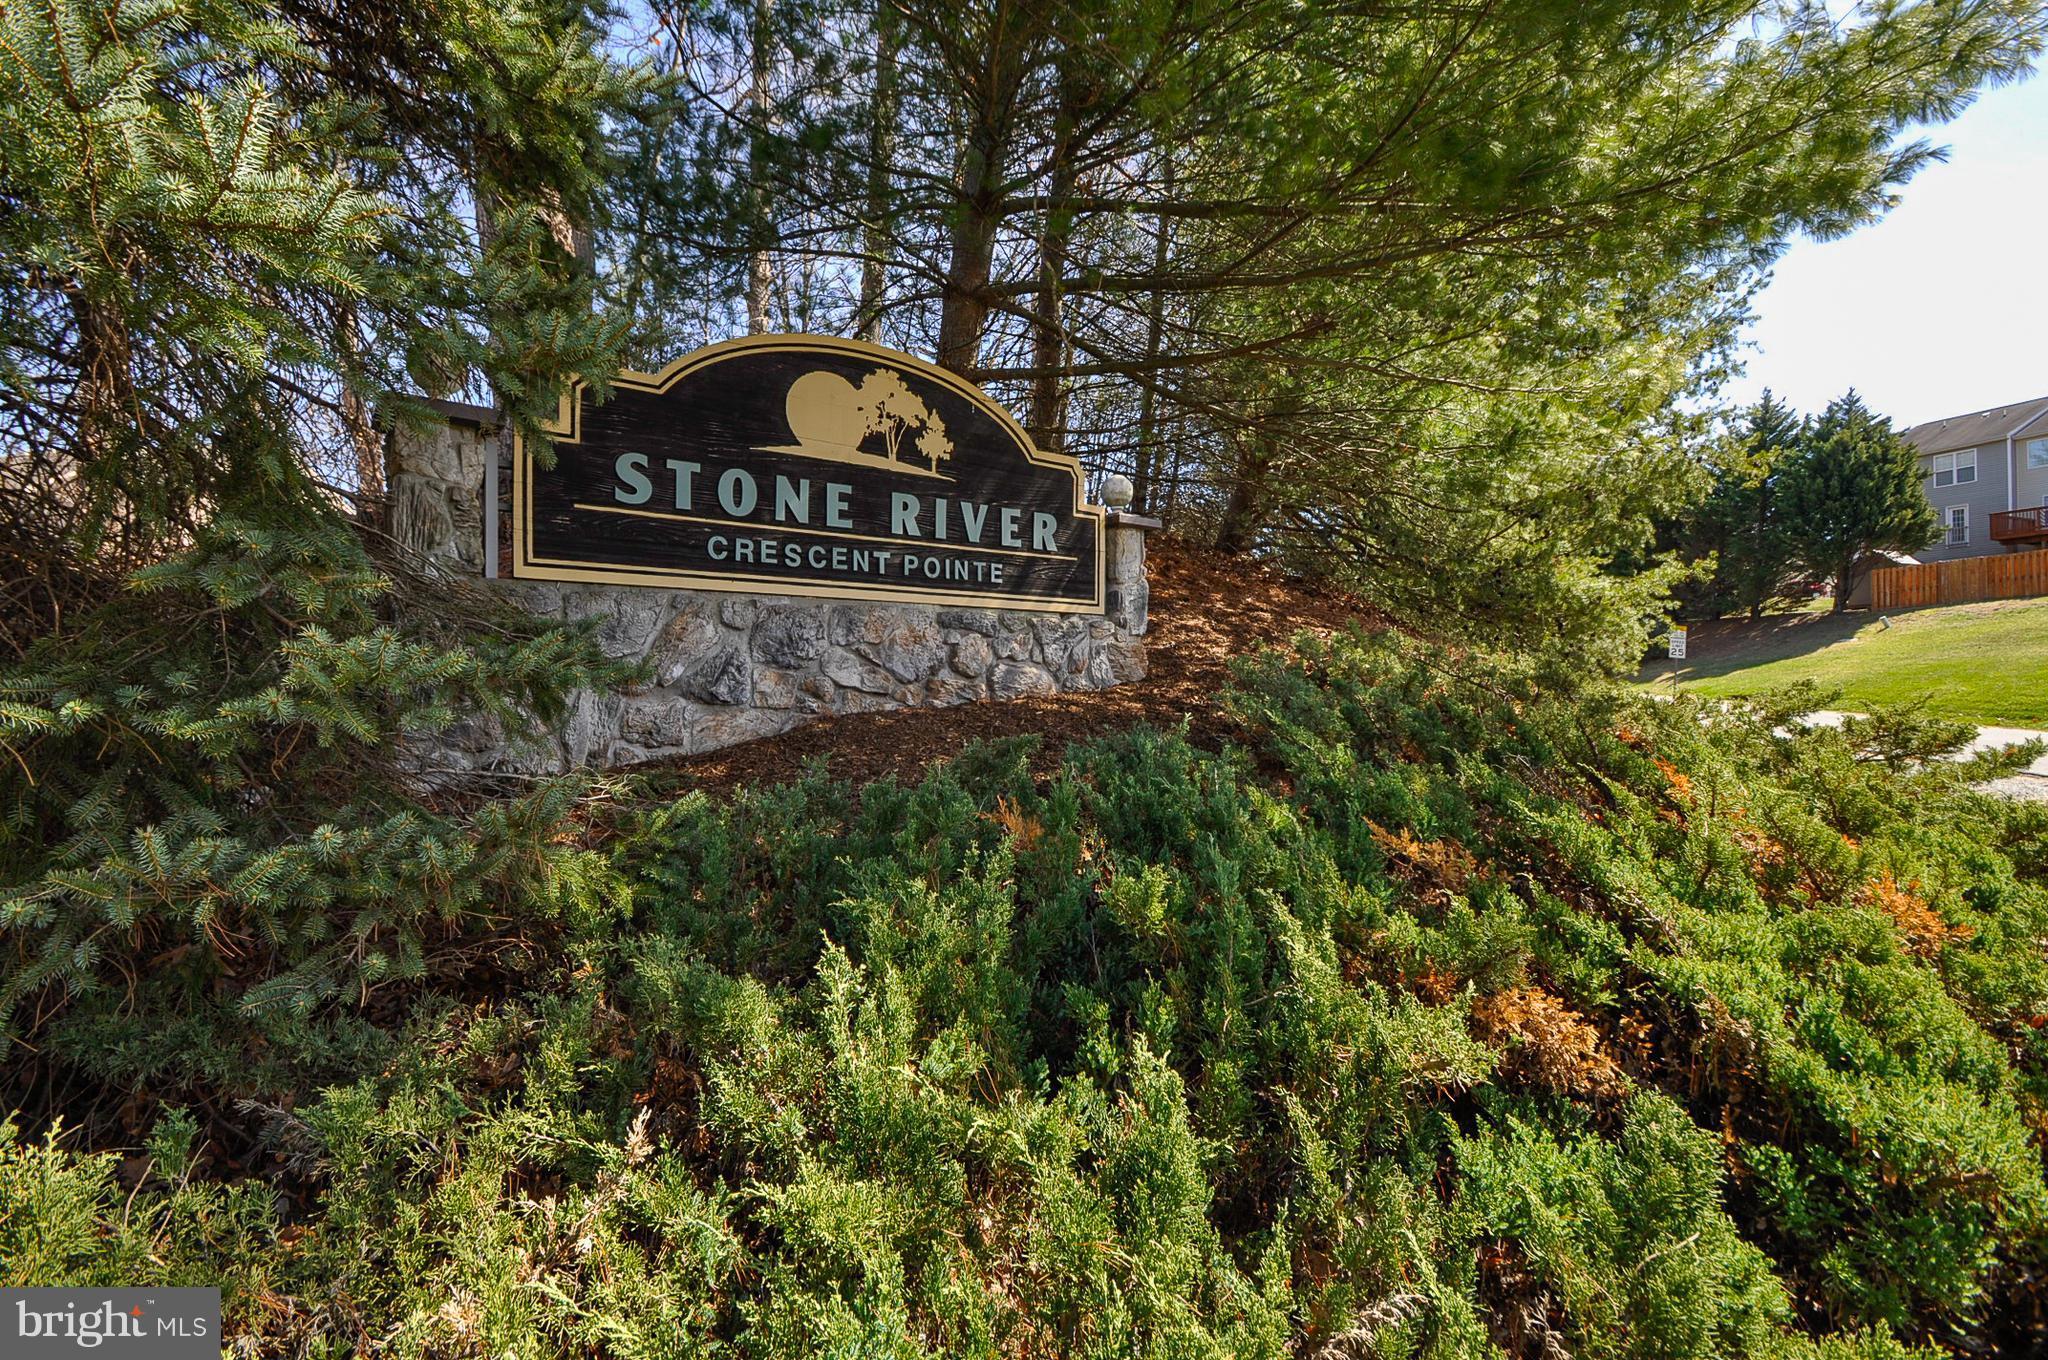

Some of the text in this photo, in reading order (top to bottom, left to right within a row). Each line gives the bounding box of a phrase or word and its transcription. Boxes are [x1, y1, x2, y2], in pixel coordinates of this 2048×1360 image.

[614, 453, 1059, 553] STONE RIVER
[706, 535, 1004, 584] CRESCENT POINTE
[1671, 648, 1684, 656] 25
